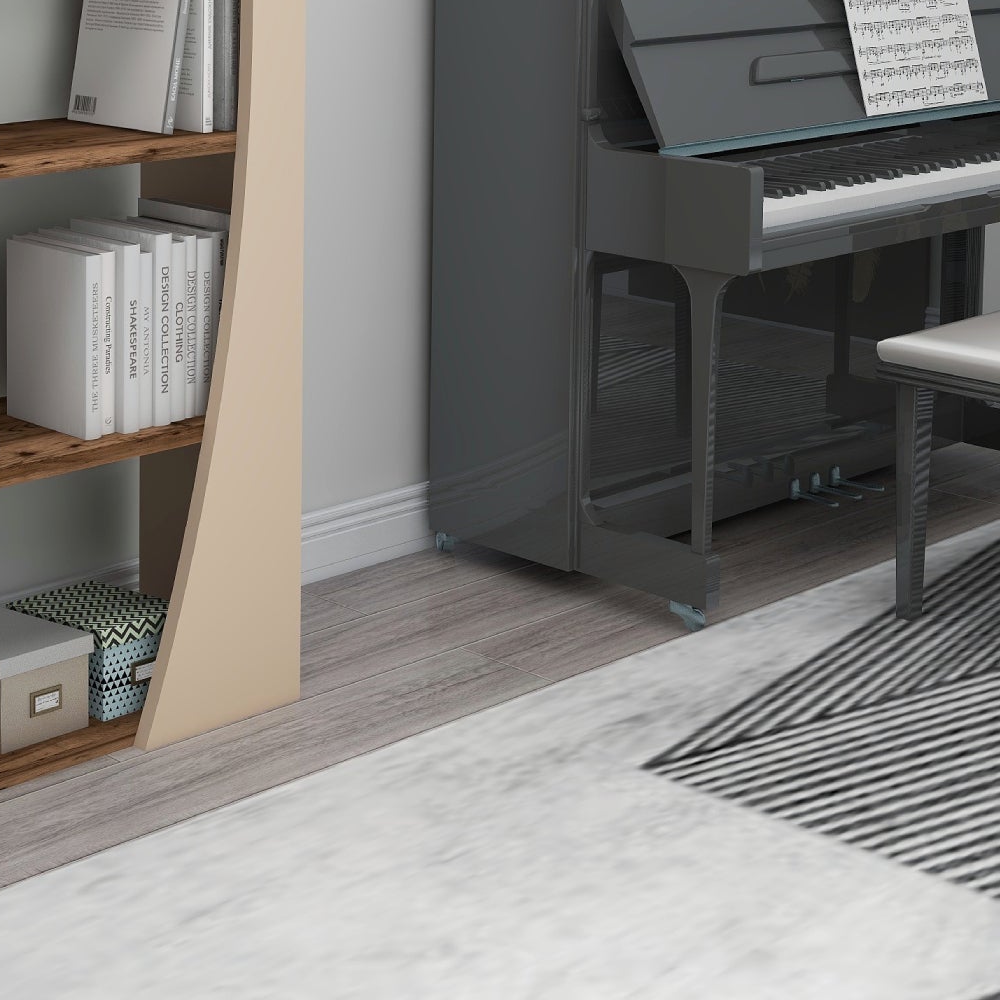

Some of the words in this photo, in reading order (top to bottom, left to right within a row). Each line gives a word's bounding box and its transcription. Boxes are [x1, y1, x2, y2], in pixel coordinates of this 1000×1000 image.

[161, 266, 170, 312] DESIGN
[187, 271, 197, 312] DESIGN
[203, 271, 211, 313] DESIGN
[129, 300, 138, 379] SHAKESPEARE
[161, 315, 169, 394] COLLECTION
[175, 302, 184, 363] CLOTHING
[186, 315, 197, 385] COLLECTION
